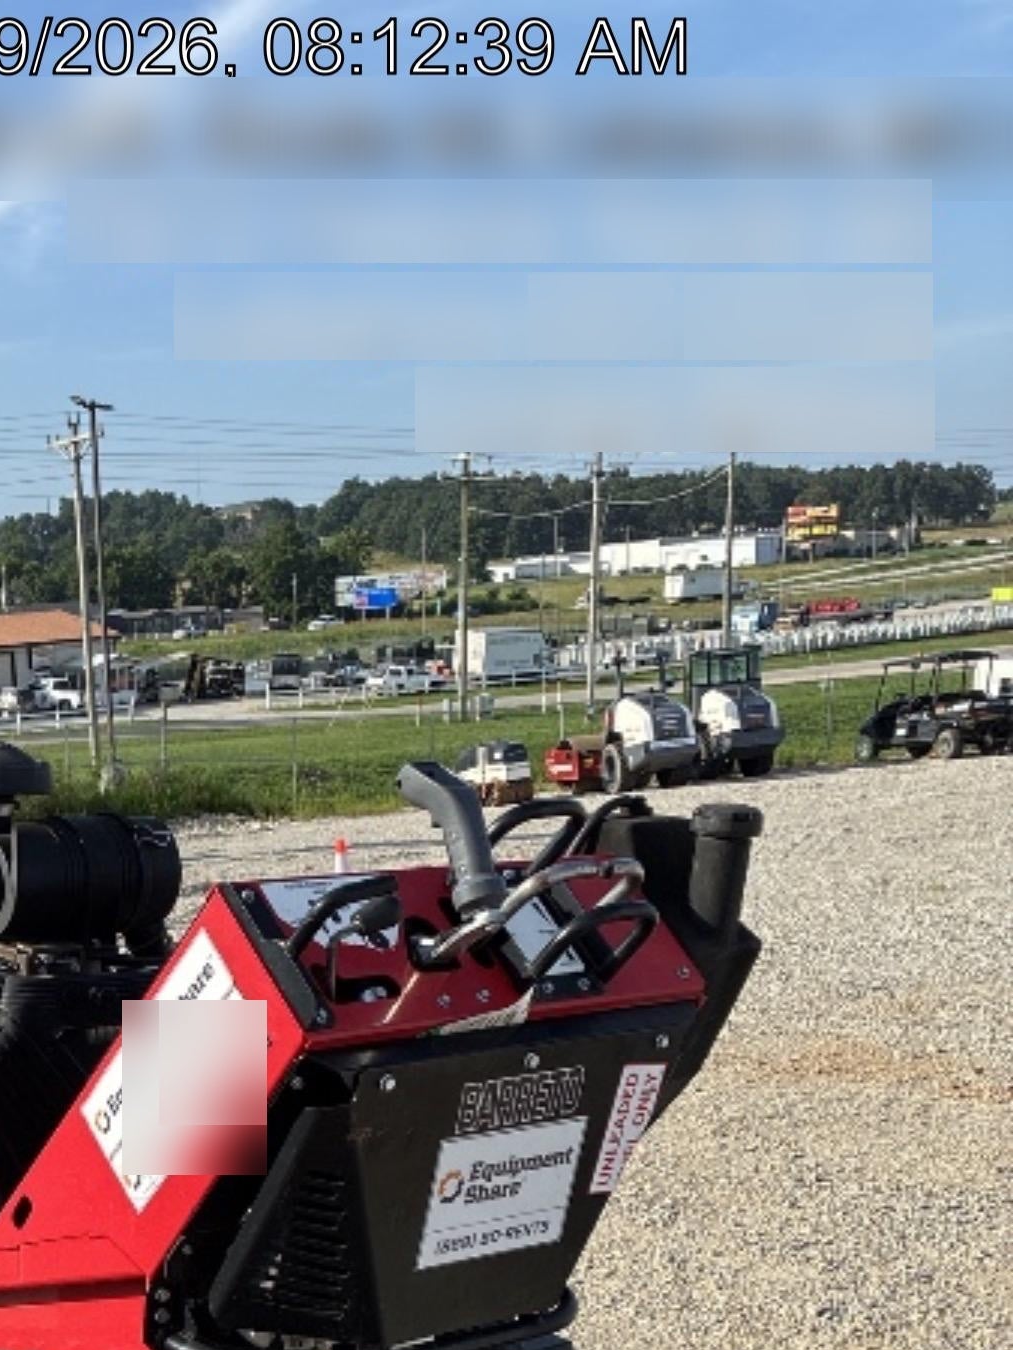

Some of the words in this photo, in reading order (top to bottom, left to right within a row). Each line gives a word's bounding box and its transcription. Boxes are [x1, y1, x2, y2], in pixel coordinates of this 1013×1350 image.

[455, 1064, 586, 1136] BARRETO
[632, 1073, 658, 1127] ONLY
[596, 1073, 638, 1185] UNLEADED
[468, 1146, 574, 1183] Equipment
[463, 1179, 523, 1206] Share
